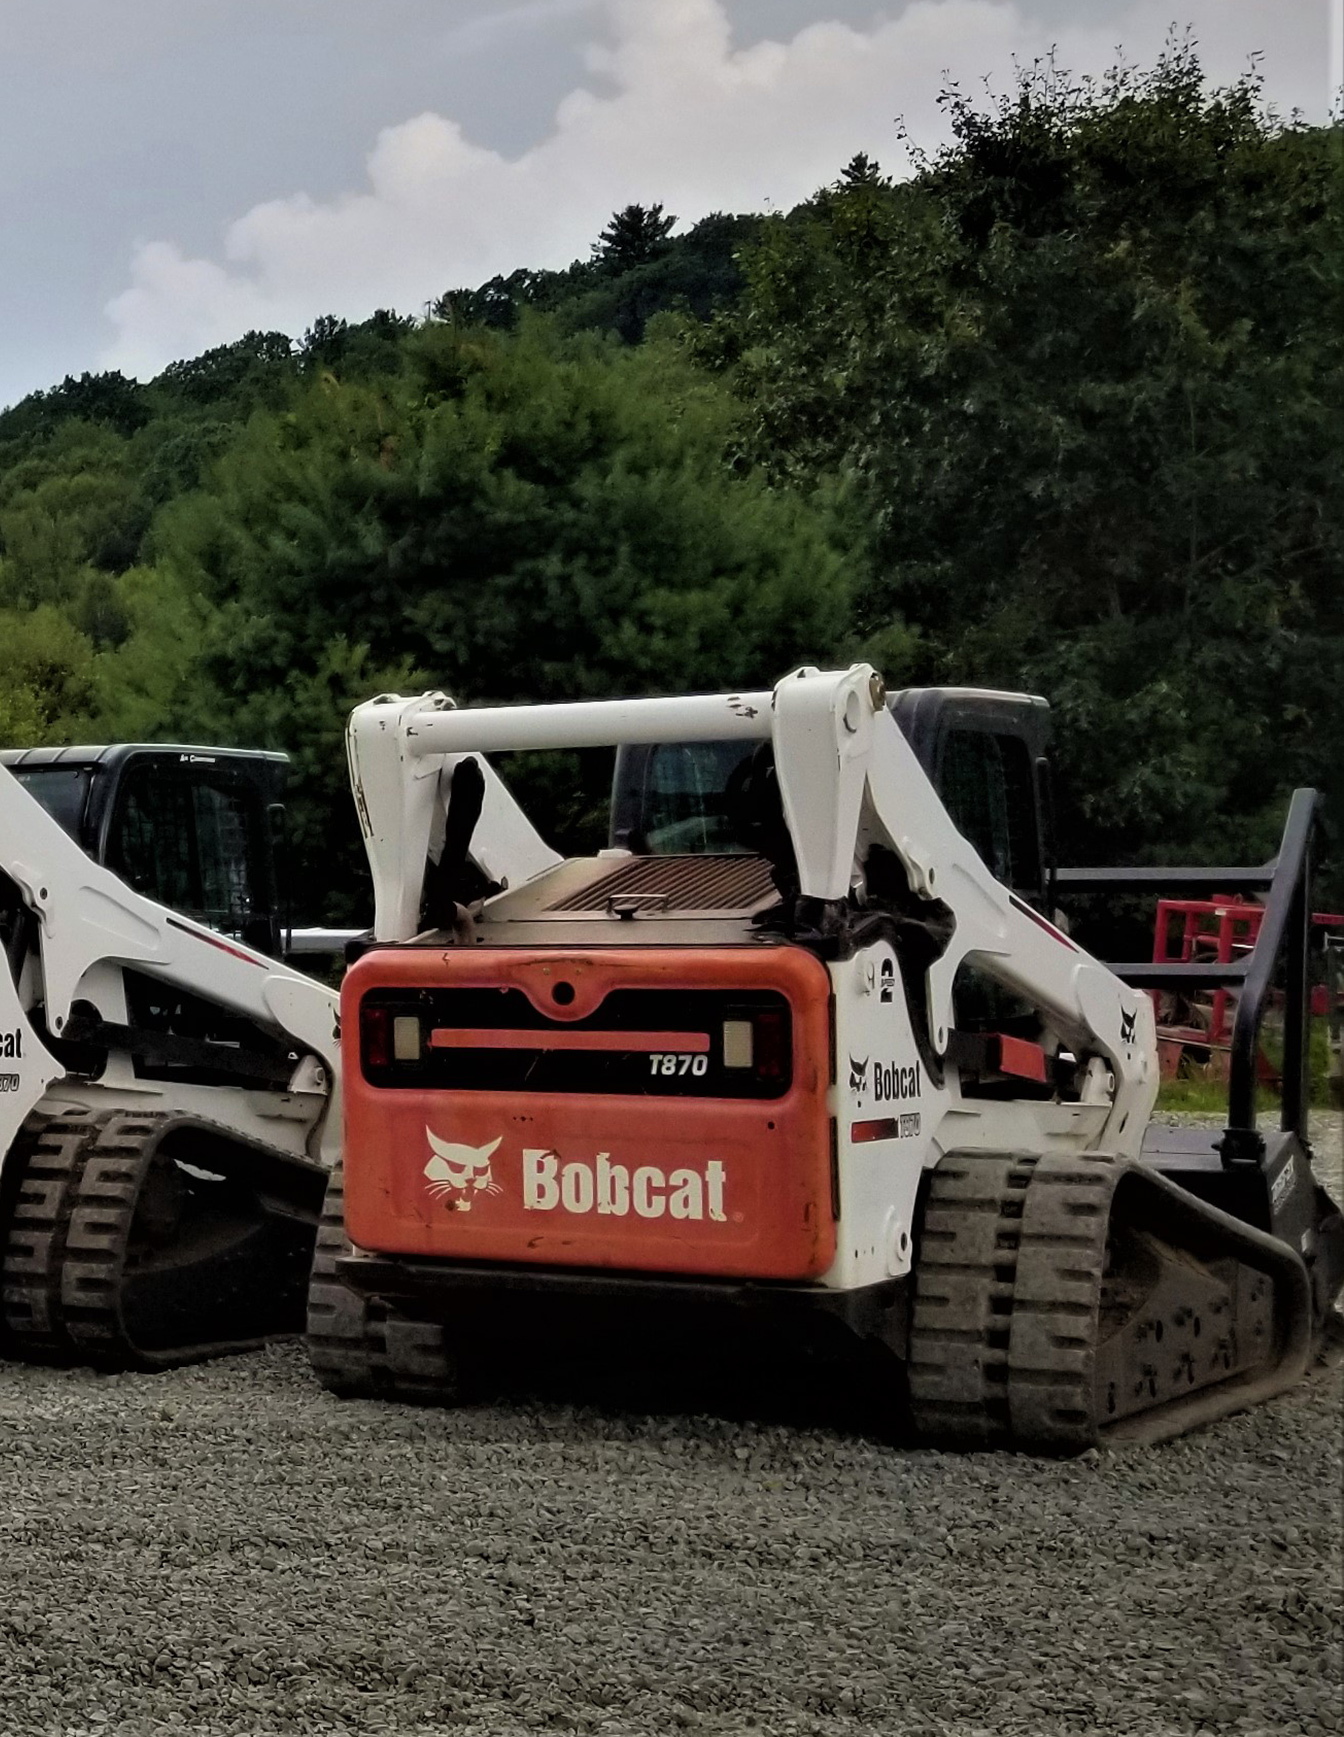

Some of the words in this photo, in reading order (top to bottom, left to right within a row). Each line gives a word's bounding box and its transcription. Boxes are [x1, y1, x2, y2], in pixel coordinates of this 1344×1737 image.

[649, 1054, 708, 1077] T870
[874, 1060, 921, 1101] Bobcat
[522, 1148, 727, 1222] Bobcat
